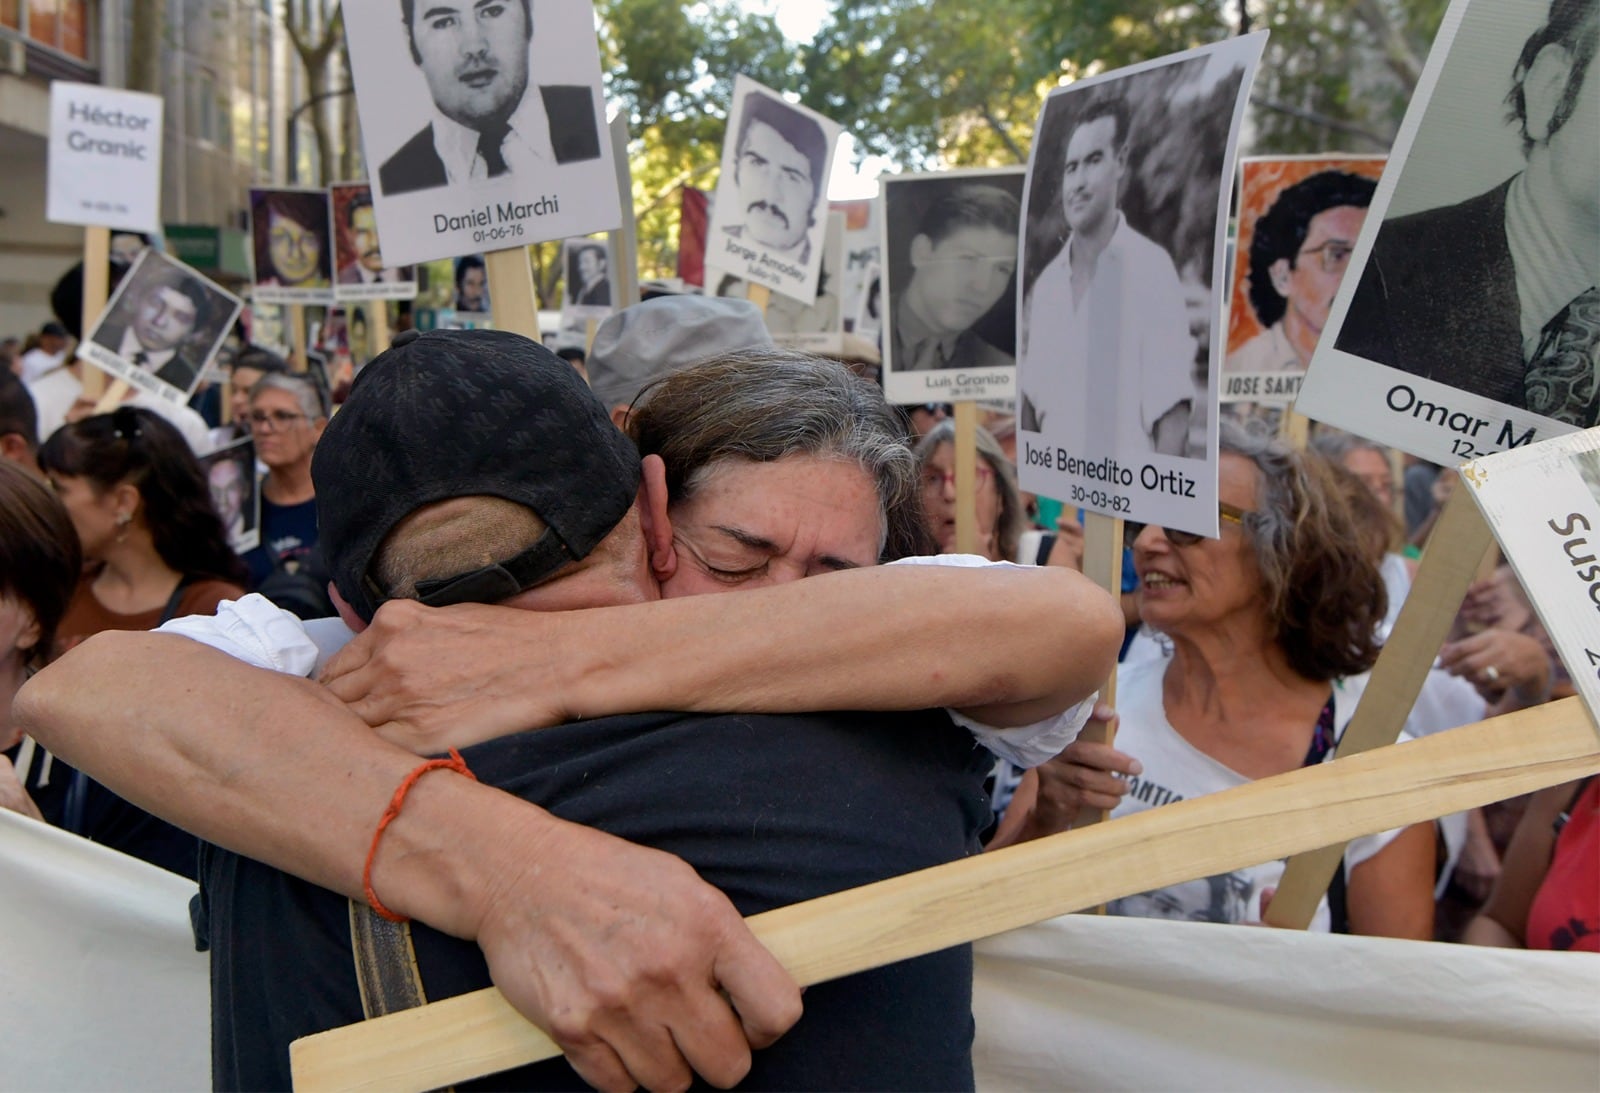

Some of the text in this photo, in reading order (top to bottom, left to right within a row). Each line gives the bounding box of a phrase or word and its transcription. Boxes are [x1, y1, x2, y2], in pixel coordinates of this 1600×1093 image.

[68, 101, 150, 131] Héctor
[67, 130, 147, 161] Granic
[434, 194, 559, 233] Daniel Marchi
[473, 223, 524, 242] 01-06-76
[725, 238, 757, 261] Jorge
[926, 372, 1009, 388] Luis Granizo
[1227, 376, 1260, 395] JOSE
[1386, 385, 1490, 437] Omar
[1451, 439, 1500, 460] 12-
[1025, 442, 1196, 498] José Benedito Ortiz
[1071, 484, 1131, 513] 30-03-82
